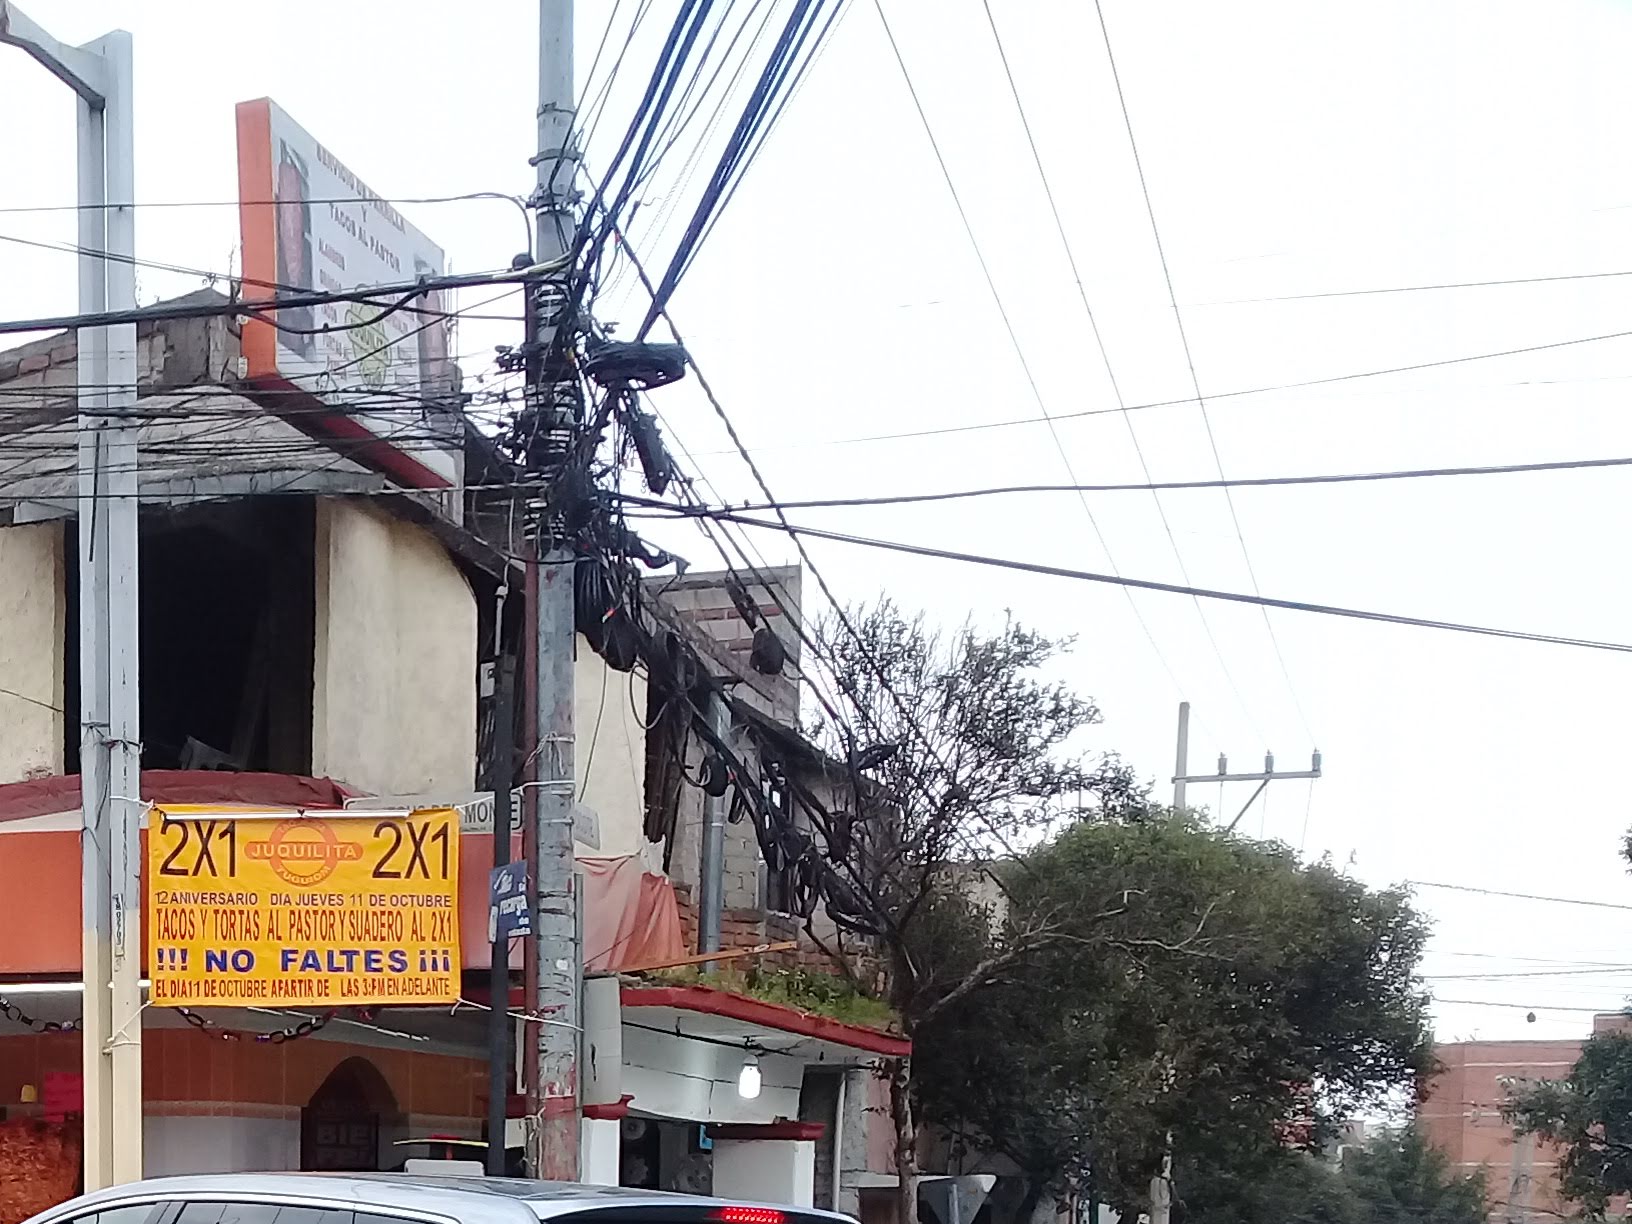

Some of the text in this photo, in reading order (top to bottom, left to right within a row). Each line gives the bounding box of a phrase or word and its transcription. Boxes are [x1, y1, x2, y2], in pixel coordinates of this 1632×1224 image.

[159, 820, 449, 880] 2X1 JUQUILITA 2X1
[170, 892, 258, 905] ANIVERSARIO
[270, 893, 292, 905] DIA
[295, 894, 344, 906] JUEVES
[350, 894, 363, 906] 11
[369, 894, 386, 906] DE
[390, 895, 452, 907] OCTUBRE
[156, 908, 195, 940] TACOS
[200, 909, 207, 940] Y
[213, 909, 260, 941] TORTAS
[267, 910, 282, 941] AL
[289, 910, 336, 942] PASTOR
[338, 911, 346, 942] Y
[349, 910, 403, 942] SUADERO
[411, 911, 426, 942] AL
[431, 911, 452, 942] 2X1
[206, 949, 255, 973] NO
[281, 949, 408, 973] FALTES
[156, 979, 167, 998] EL
[204, 980, 217, 998] DE
[219, 980, 267, 998] OCTUBRE
[317, 979, 330, 997] DE
[341, 979, 360, 997] LAS
[387, 978, 400, 996] EN
[401, 978, 451, 996] ADELANTE
